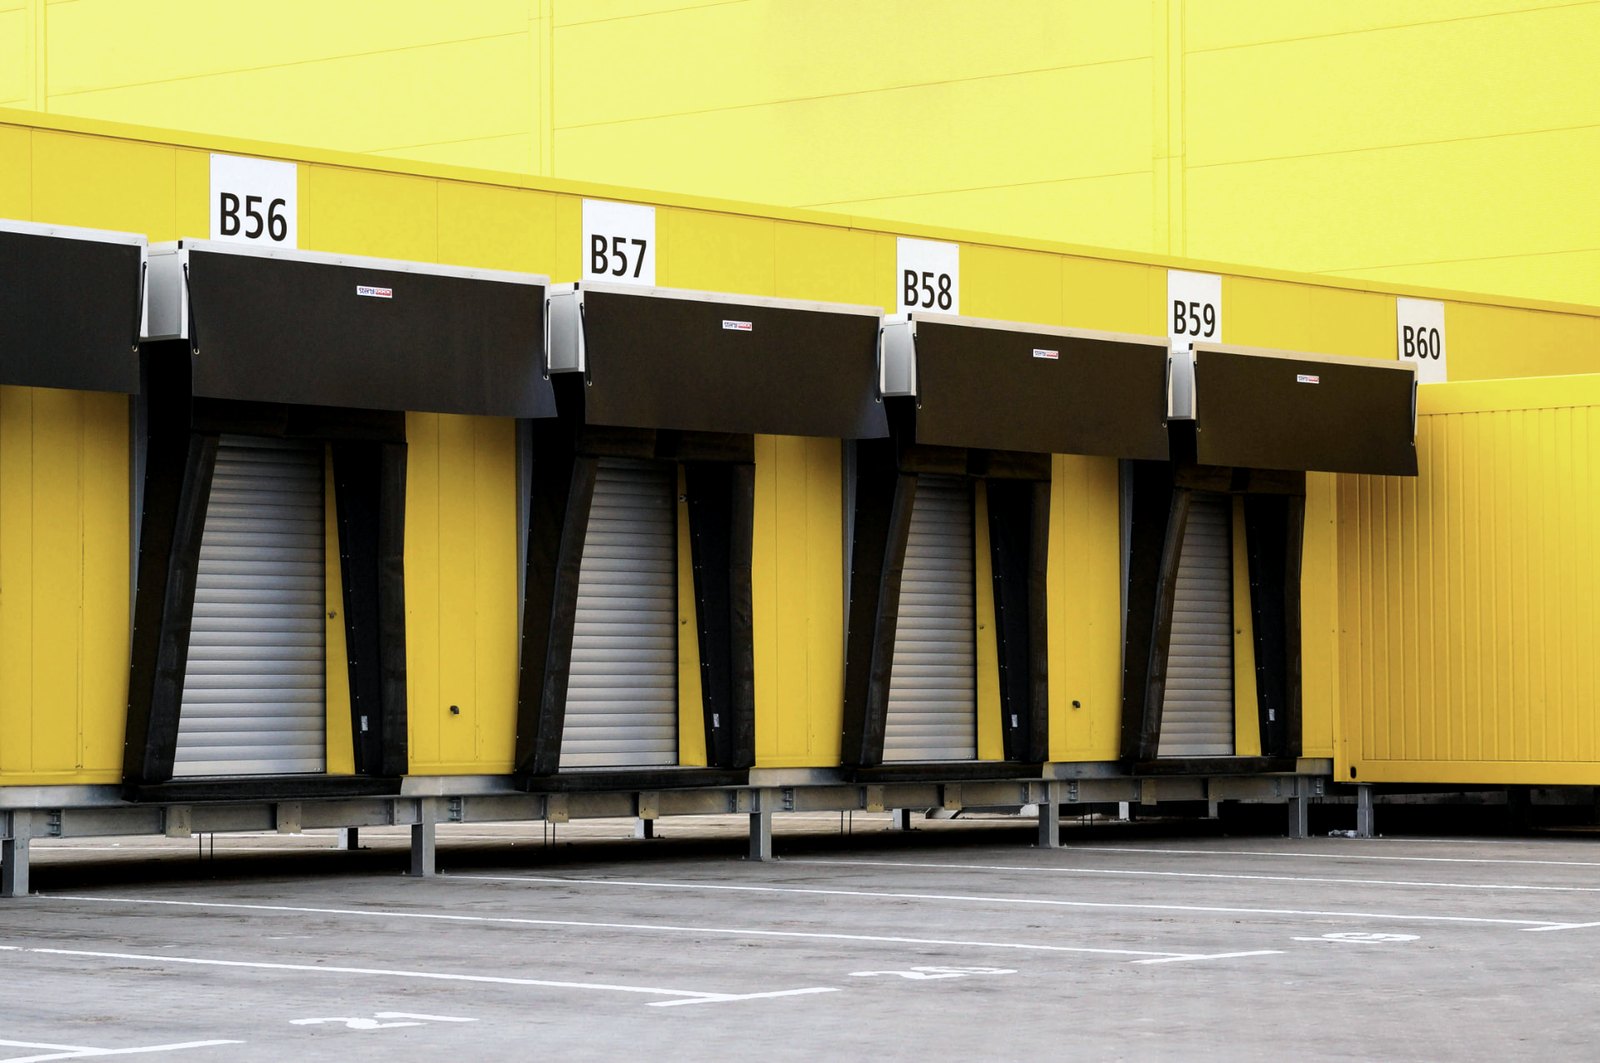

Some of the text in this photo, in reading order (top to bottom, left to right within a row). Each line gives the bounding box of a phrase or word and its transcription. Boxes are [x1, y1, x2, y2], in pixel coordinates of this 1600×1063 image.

[220, 192, 288, 241] B56
[591, 235, 647, 278] B57
[904, 269, 952, 311] B58
[1173, 299, 1216, 338] B59
[1403, 325, 1441, 360] B60
